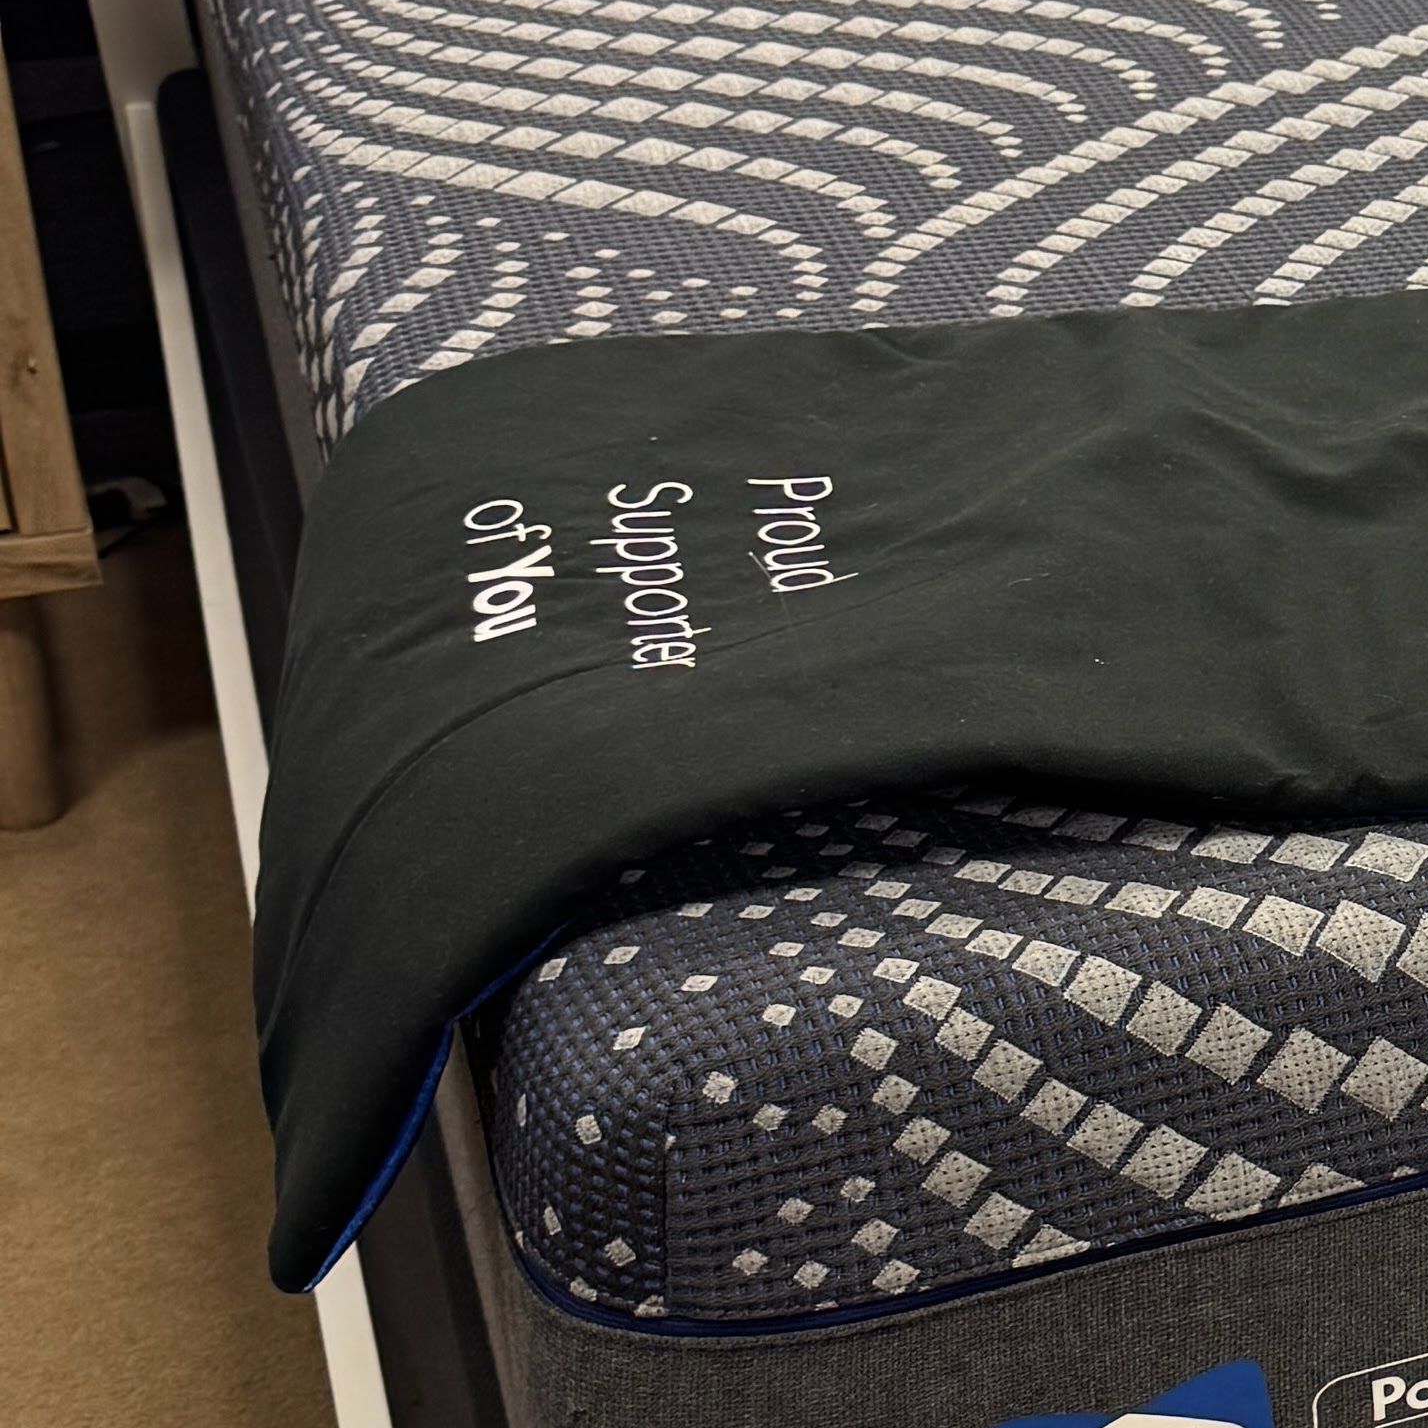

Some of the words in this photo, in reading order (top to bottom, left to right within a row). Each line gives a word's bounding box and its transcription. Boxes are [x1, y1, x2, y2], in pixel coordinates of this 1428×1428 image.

[463, 498, 553, 545] of
[589, 481, 712, 670] Supporter
[747, 475, 859, 593] Proud
[466, 545, 555, 643] You
